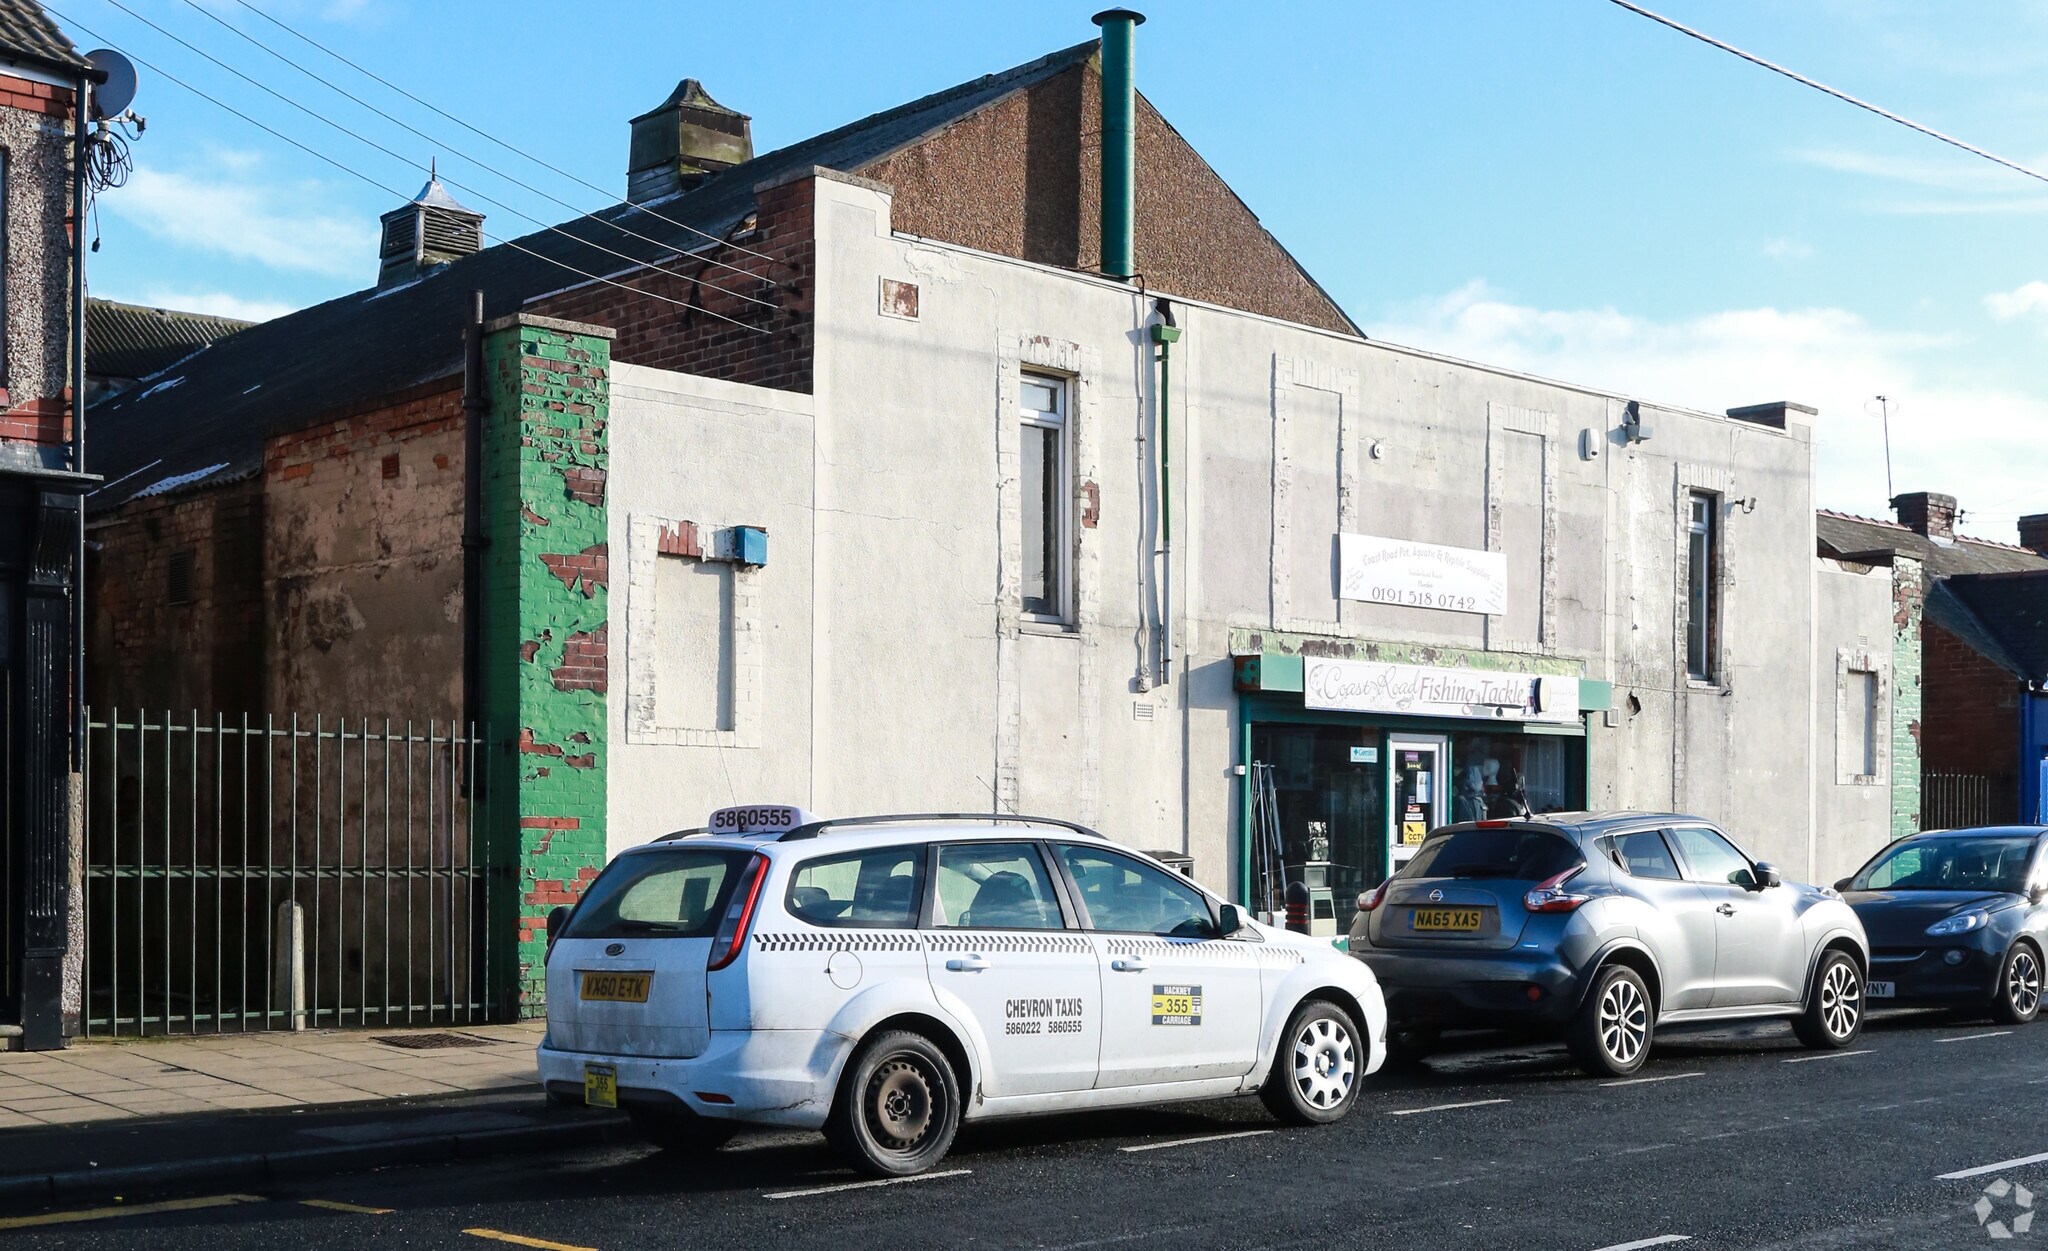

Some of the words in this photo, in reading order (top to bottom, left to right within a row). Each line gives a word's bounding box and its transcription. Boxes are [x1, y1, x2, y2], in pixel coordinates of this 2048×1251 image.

[1363, 554, 1381, 566] Coast
[1382, 549, 1397, 562] Road
[1412, 546, 1435, 560] Aquatic
[1444, 551, 1464, 567] Reptile
[1466, 560, 1490, 581] Supplies
[1371, 586, 1402, 603] 0191
[1407, 590, 1433, 606] 518
[1438, 593, 1475, 610] 0742
[1324, 666, 1370, 699] Coast
[1376, 666, 1420, 699] Road
[1419, 675, 1475, 715] Fishing
[715, 809, 792, 828] 5860555
[1416, 911, 1450, 926] NA65
[1452, 913, 1479, 927] XAS
[587, 976, 616, 997] VX60
[1163, 986, 1192, 995] HACKNEY
[1005, 999, 1053, 1018] CHEVRON
[1055, 998, 1083, 1017] TAXIS
[1166, 998, 1188, 1013] 355
[1005, 1022, 1041, 1035] 5860222
[1048, 1020, 1082, 1033] 5860555
[1162, 1015, 1192, 1025] CARRIAGE
